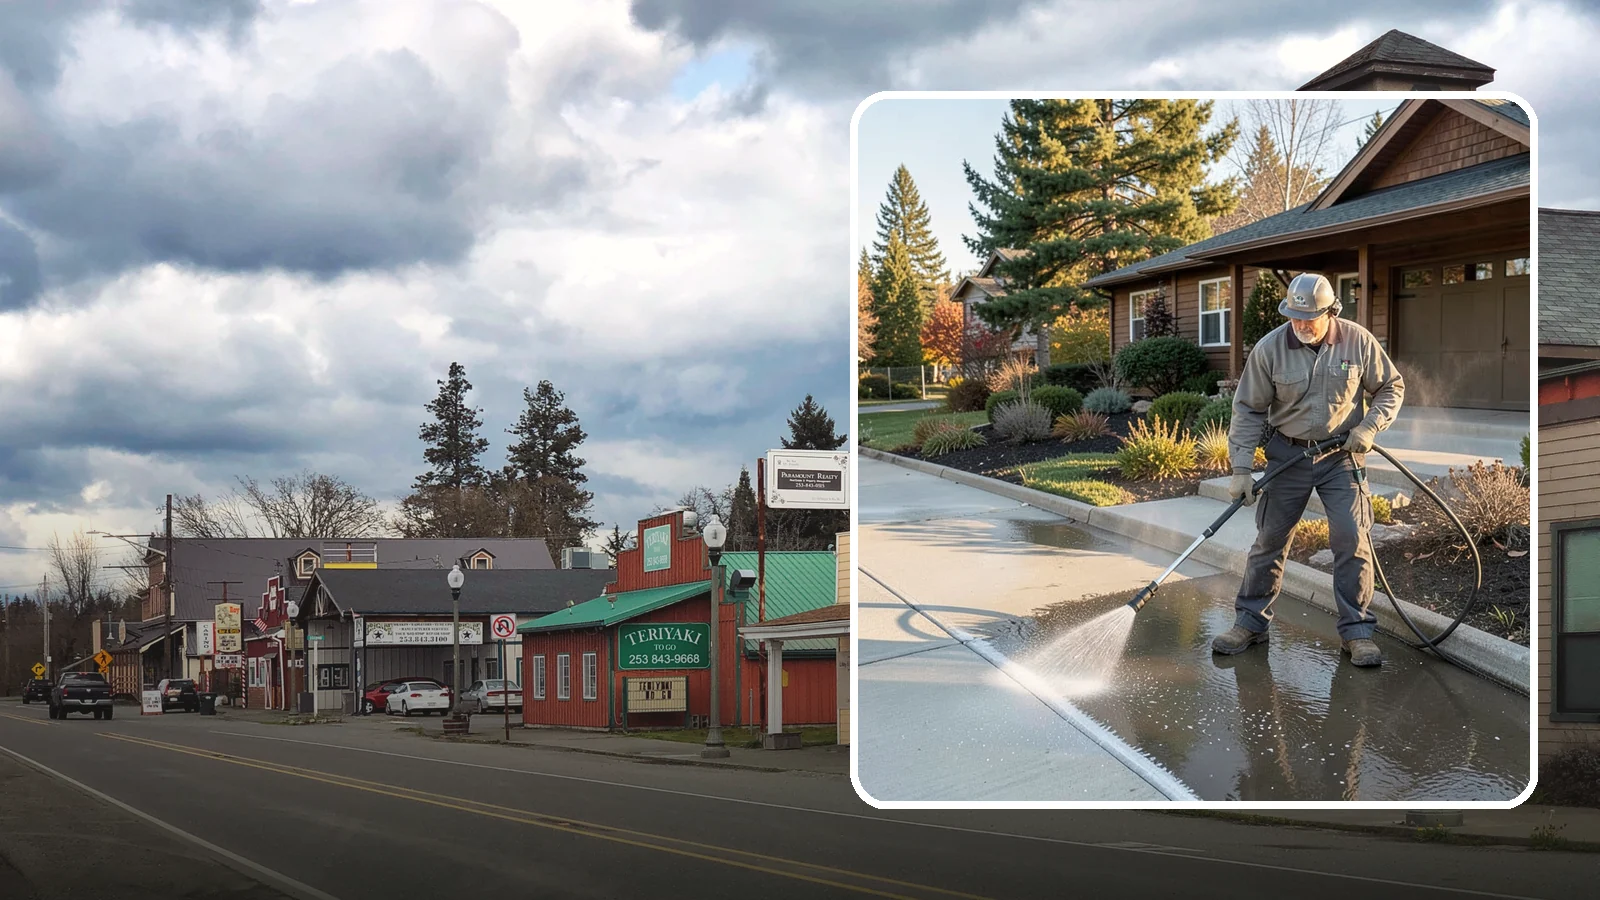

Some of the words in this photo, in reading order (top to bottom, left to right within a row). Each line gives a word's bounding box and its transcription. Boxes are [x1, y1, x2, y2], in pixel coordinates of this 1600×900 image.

[625, 627, 702, 646] TERIYAKI
[629, 654, 648, 664] 253
[652, 654, 700, 664] 843-9668
